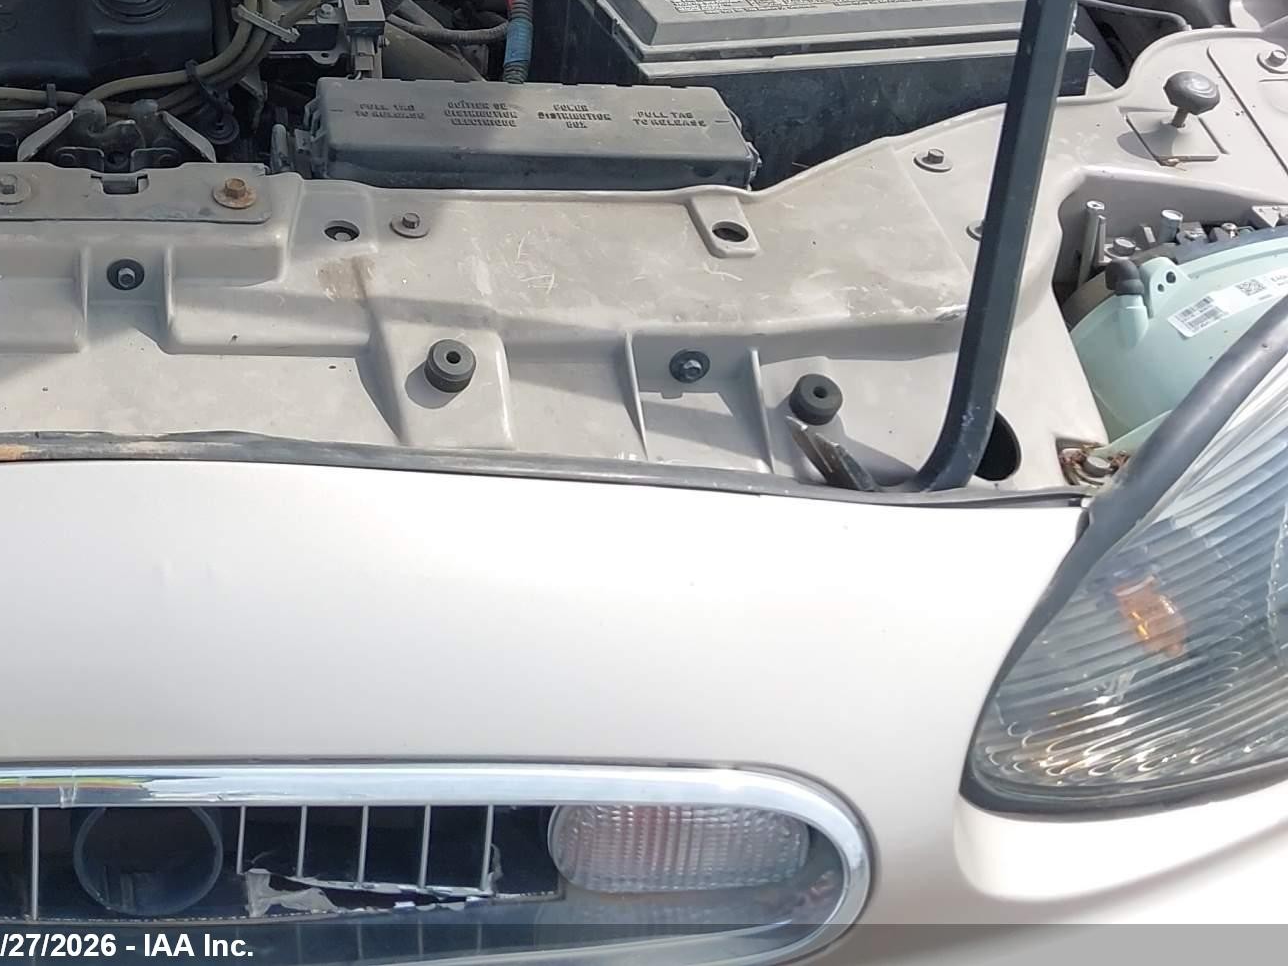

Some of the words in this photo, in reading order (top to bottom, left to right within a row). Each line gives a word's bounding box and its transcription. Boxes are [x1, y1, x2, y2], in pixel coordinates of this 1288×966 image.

[636, 111, 668, 119] PULL
[670, 112, 694, 120] TAG
[632, 118, 650, 126] TO
[652, 119, 708, 127] RELEASE
